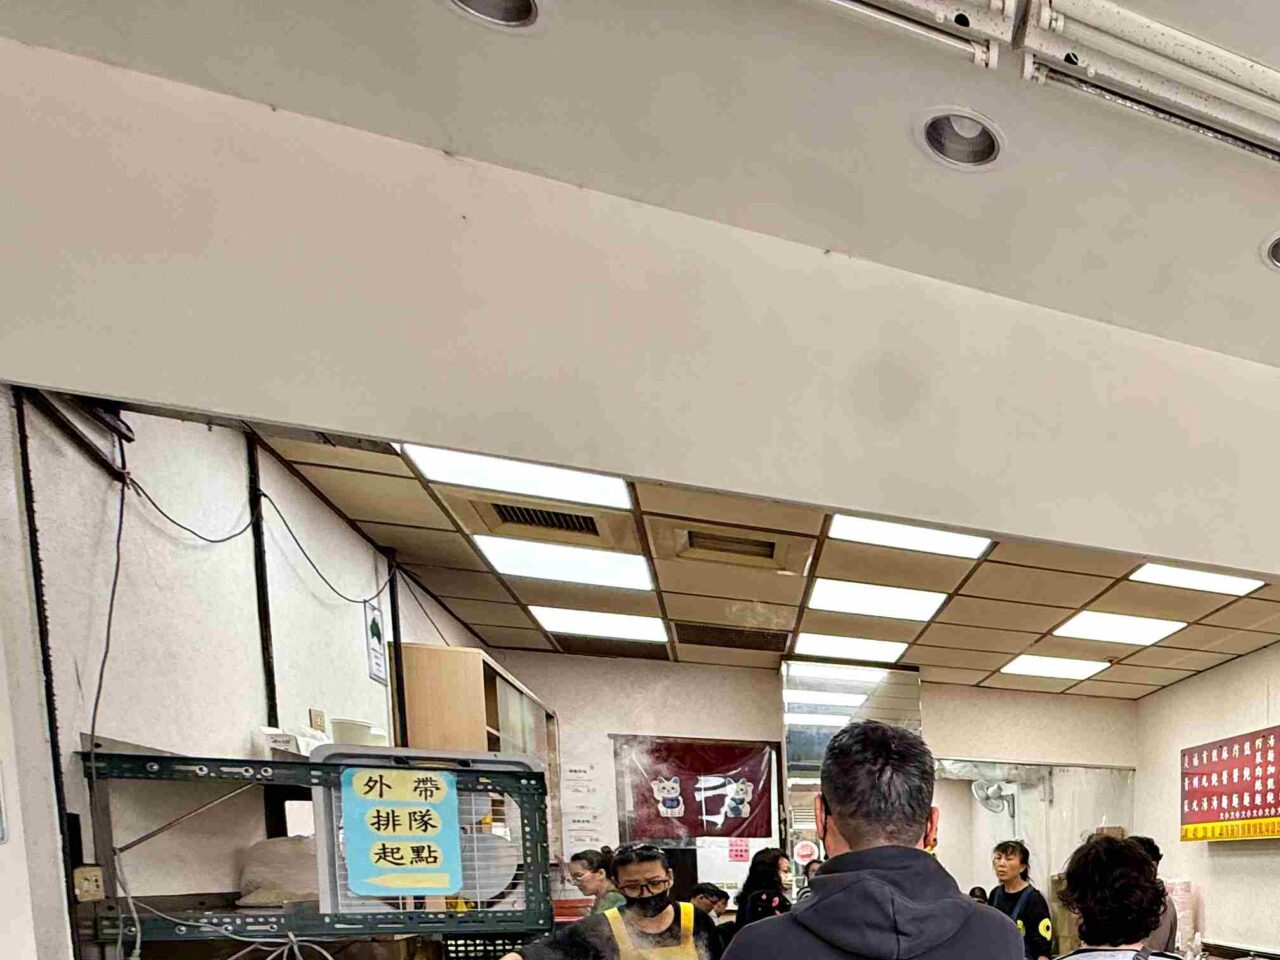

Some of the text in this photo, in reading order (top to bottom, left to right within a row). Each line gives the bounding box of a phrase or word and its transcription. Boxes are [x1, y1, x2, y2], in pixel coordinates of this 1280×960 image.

[363, 774, 442, 801] 外帶
[370, 809, 439, 833] 排隊
[374, 843, 440, 866] 起點
